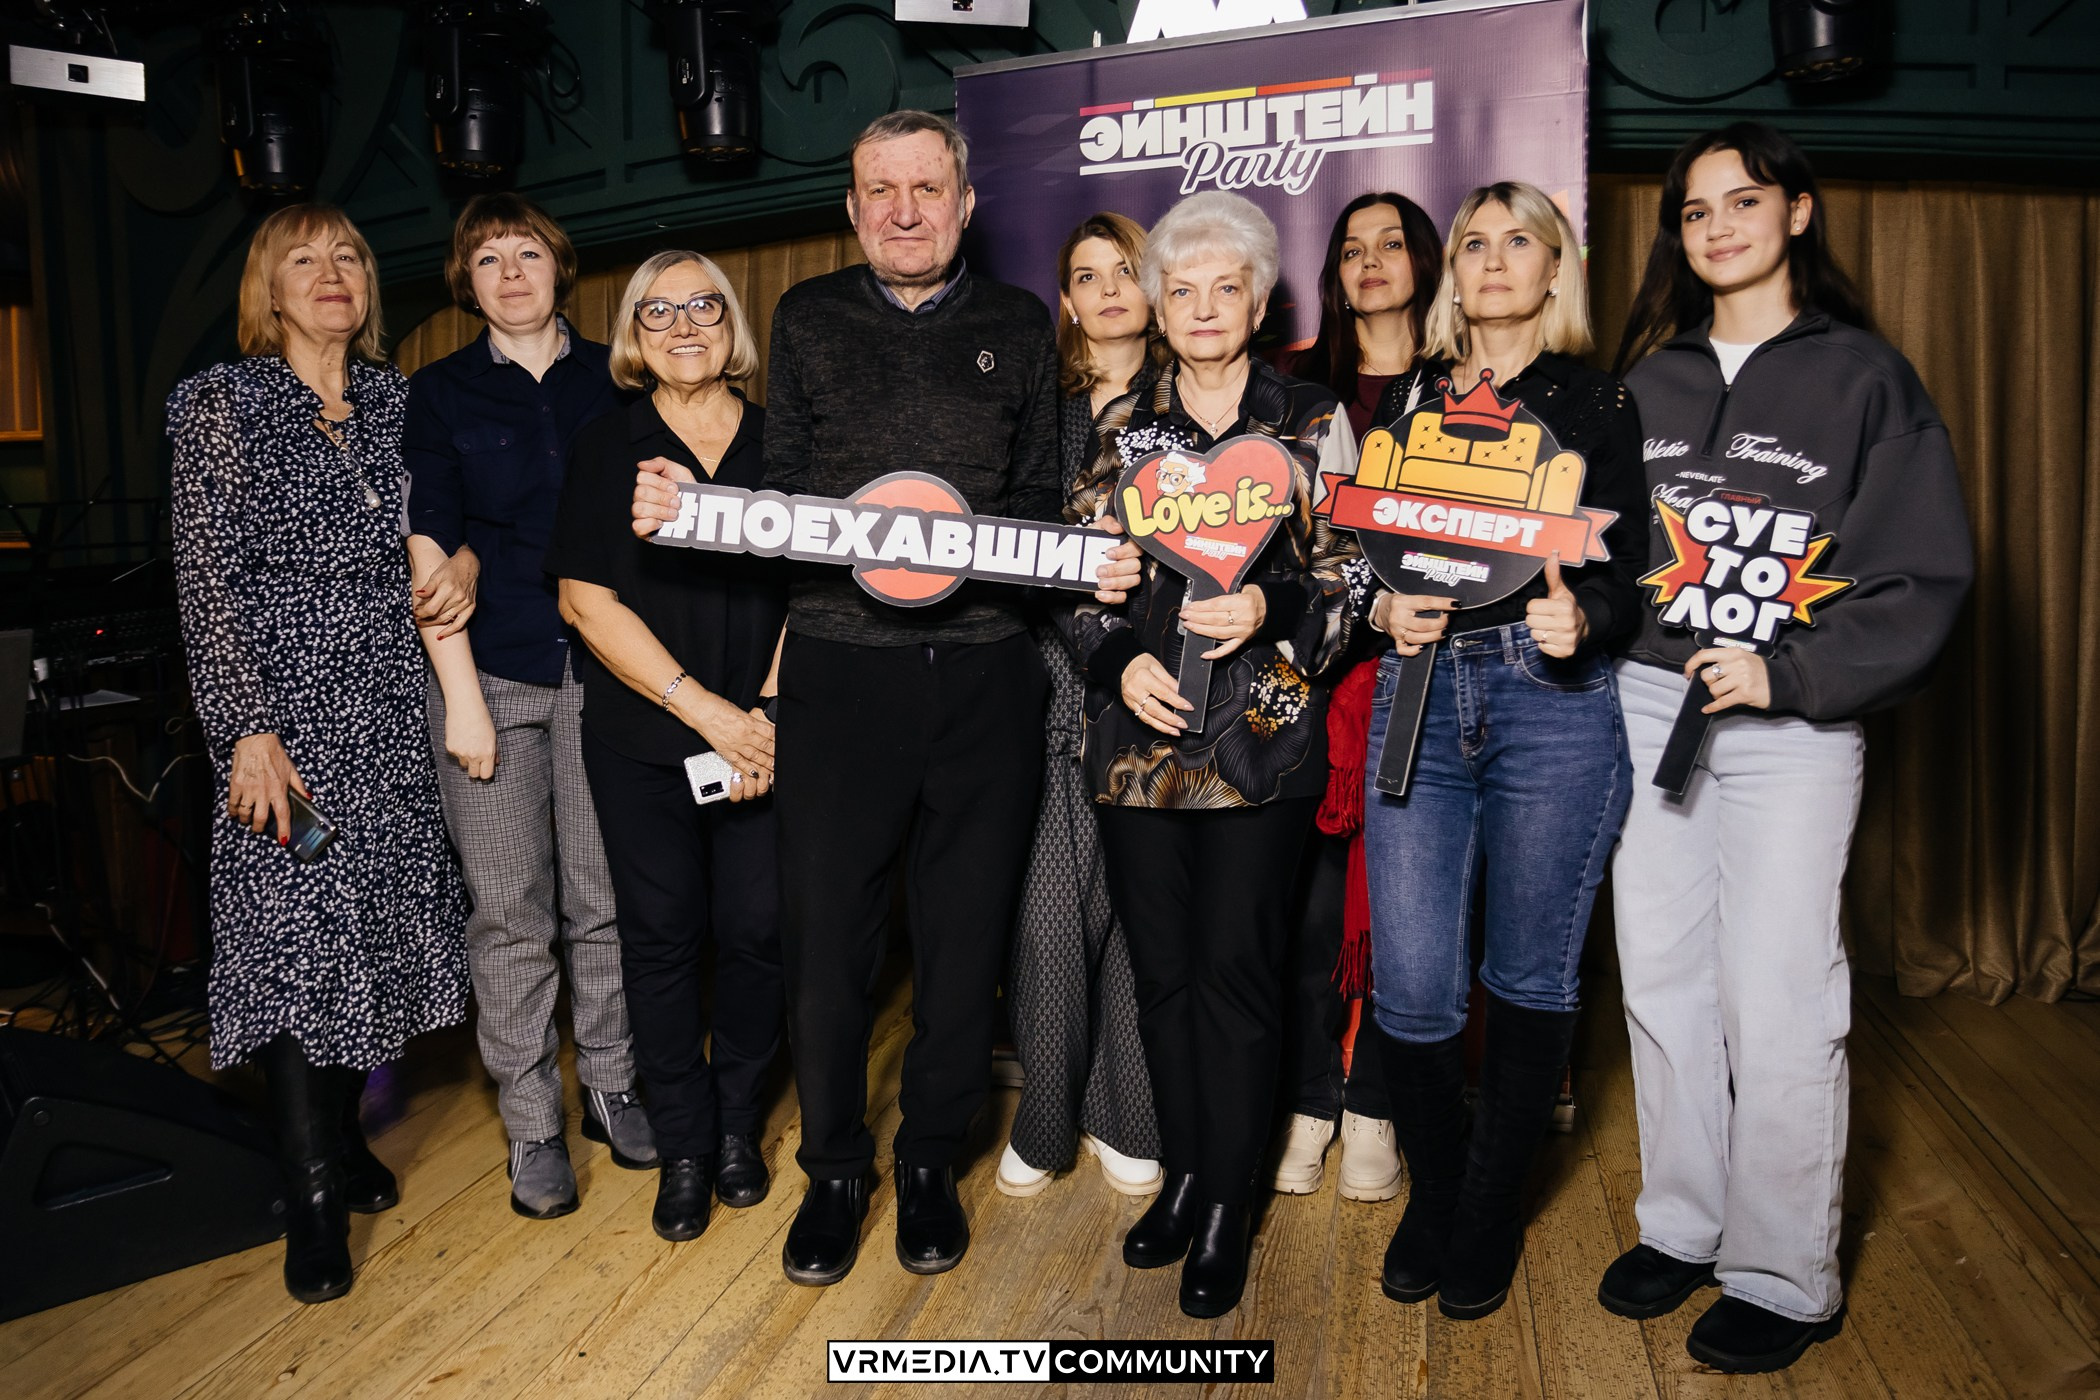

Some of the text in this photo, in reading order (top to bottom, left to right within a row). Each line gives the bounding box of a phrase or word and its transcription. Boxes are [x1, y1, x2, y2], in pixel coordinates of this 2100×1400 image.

[1079, 73, 1434, 163] ЭЙНШТЕЙН
[1179, 134, 1325, 196] Party
[1725, 433, 1828, 484] Training
[1122, 476, 1293, 538] Love is...
[1372, 497, 1544, 548] ЭКСПЕРТ
[1687, 501, 1812, 556] СУЕ
[1423, 567, 1461, 587] Party
[1704, 545, 1788, 598] ТО
[1662, 586, 1792, 642] ЛОГ
